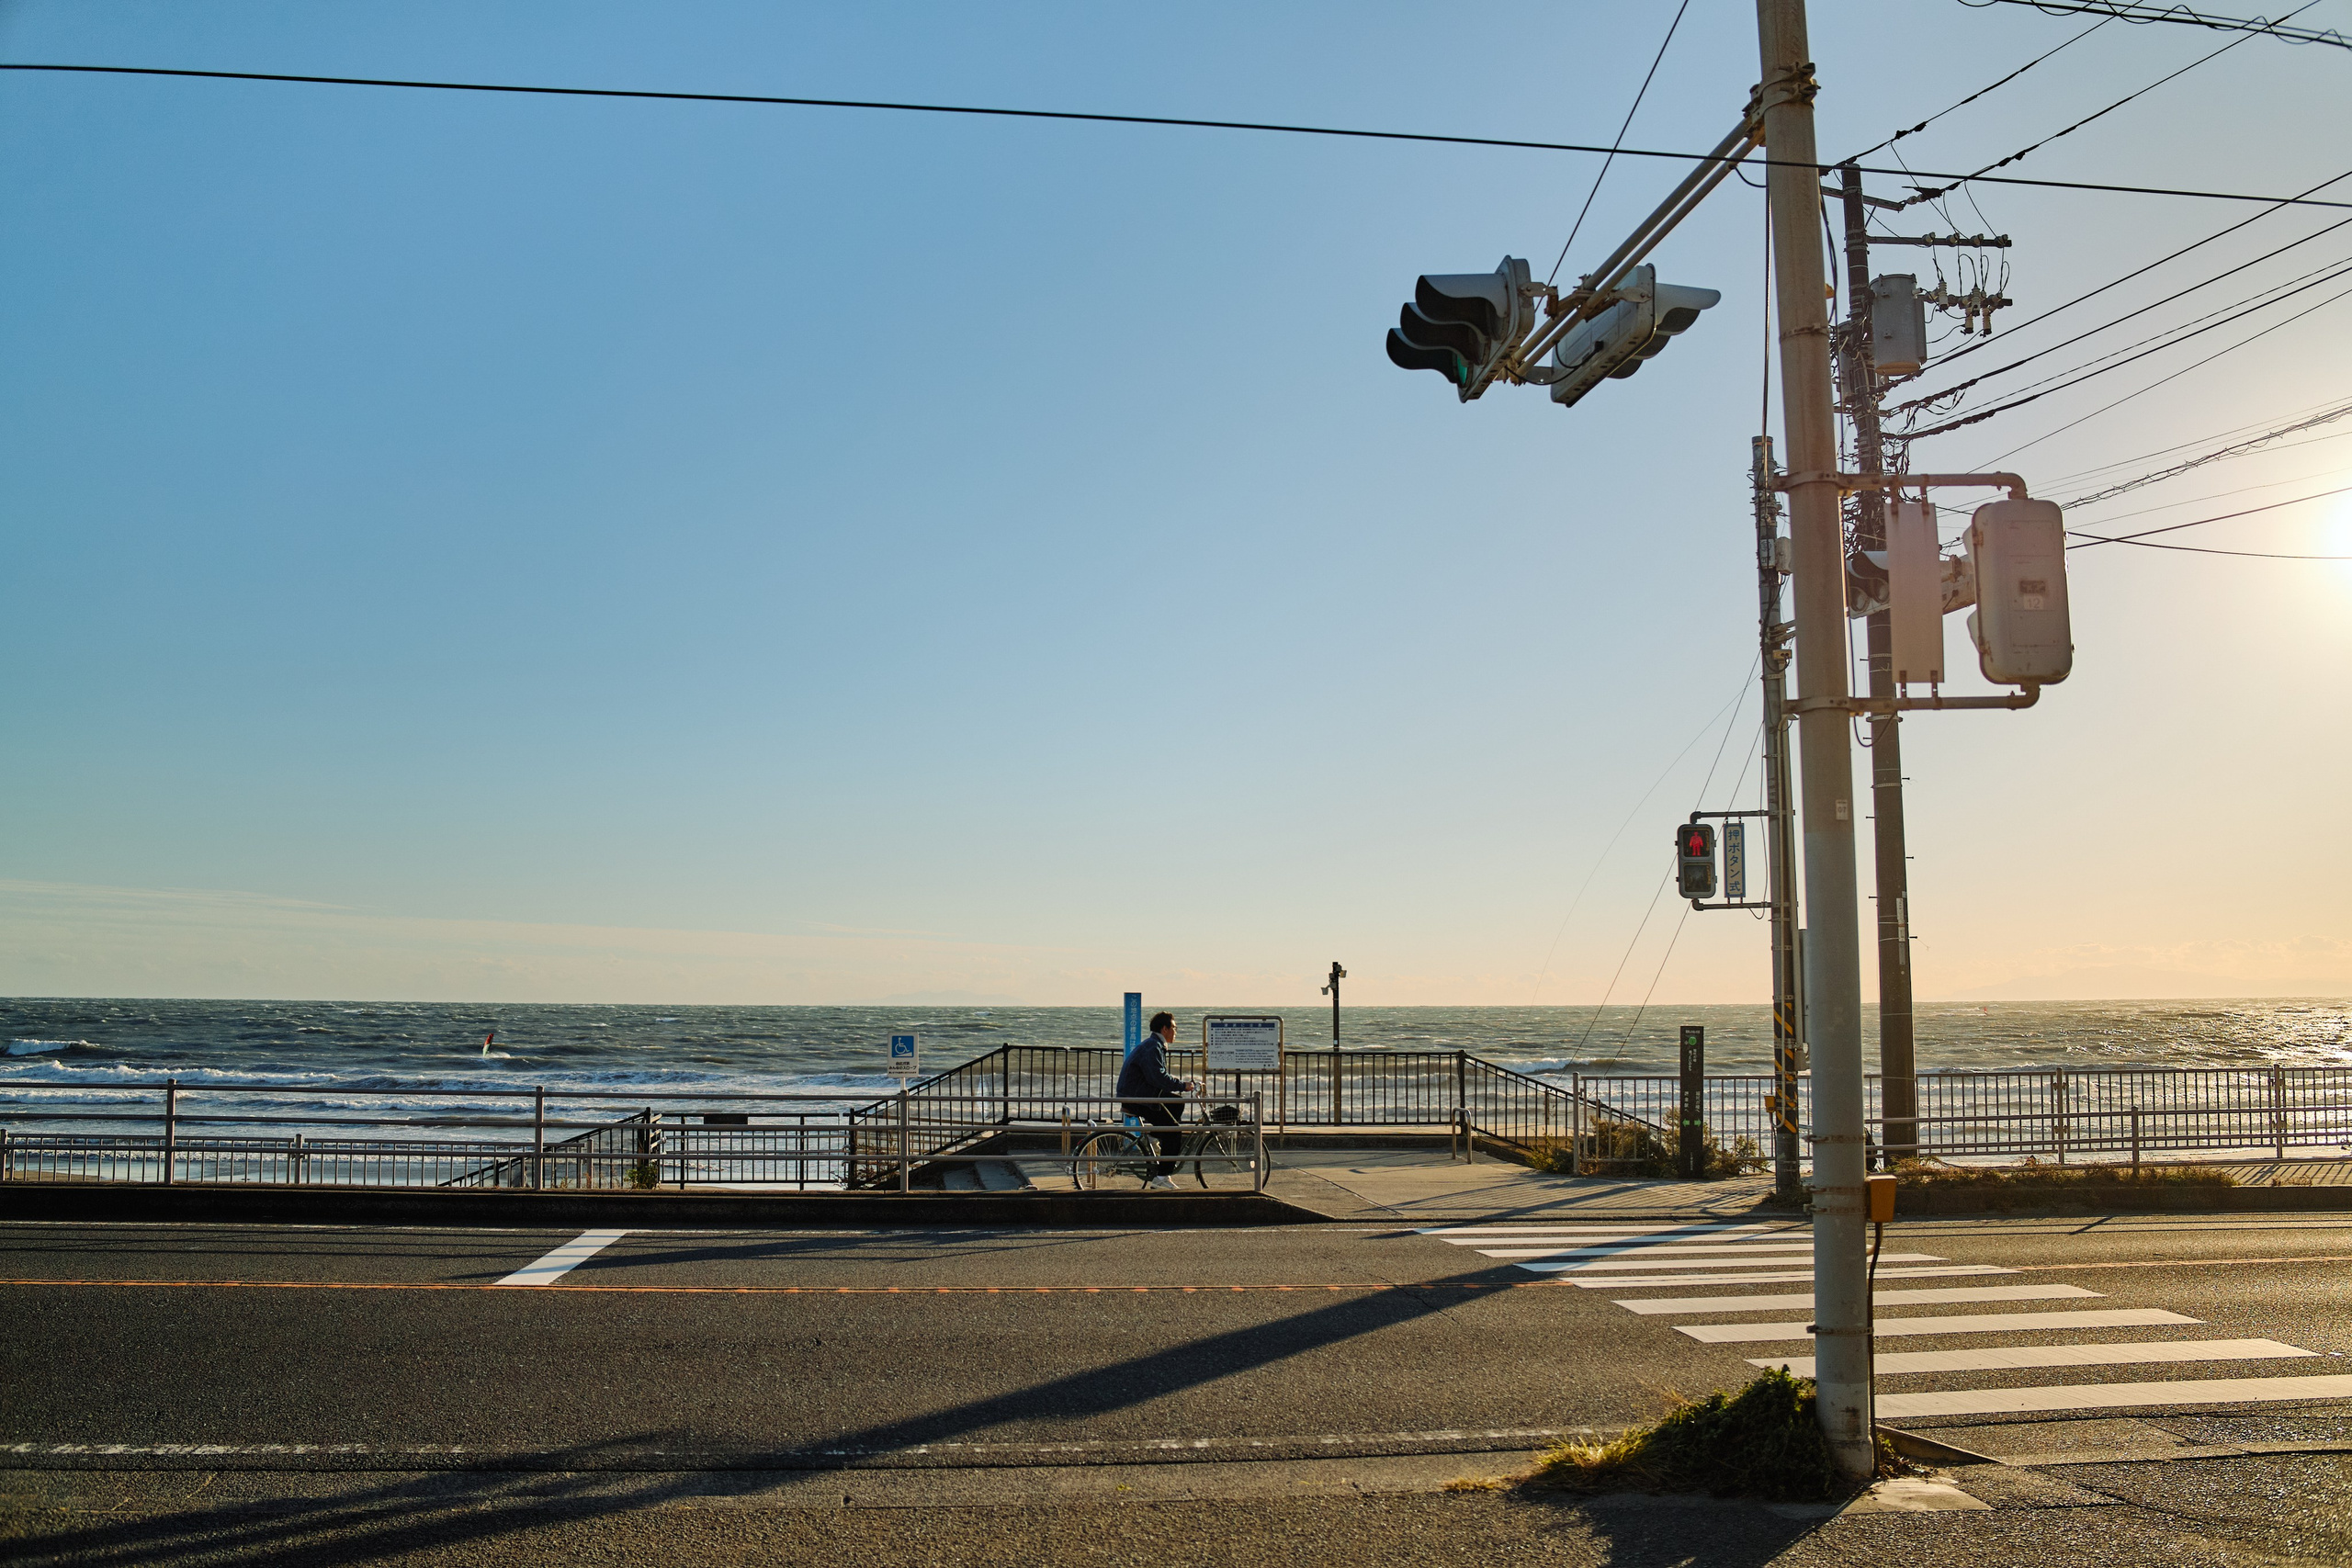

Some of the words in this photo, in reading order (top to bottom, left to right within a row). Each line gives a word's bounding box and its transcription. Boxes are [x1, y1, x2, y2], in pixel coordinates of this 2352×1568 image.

[1728, 829, 1740, 892] 押ボタン式
